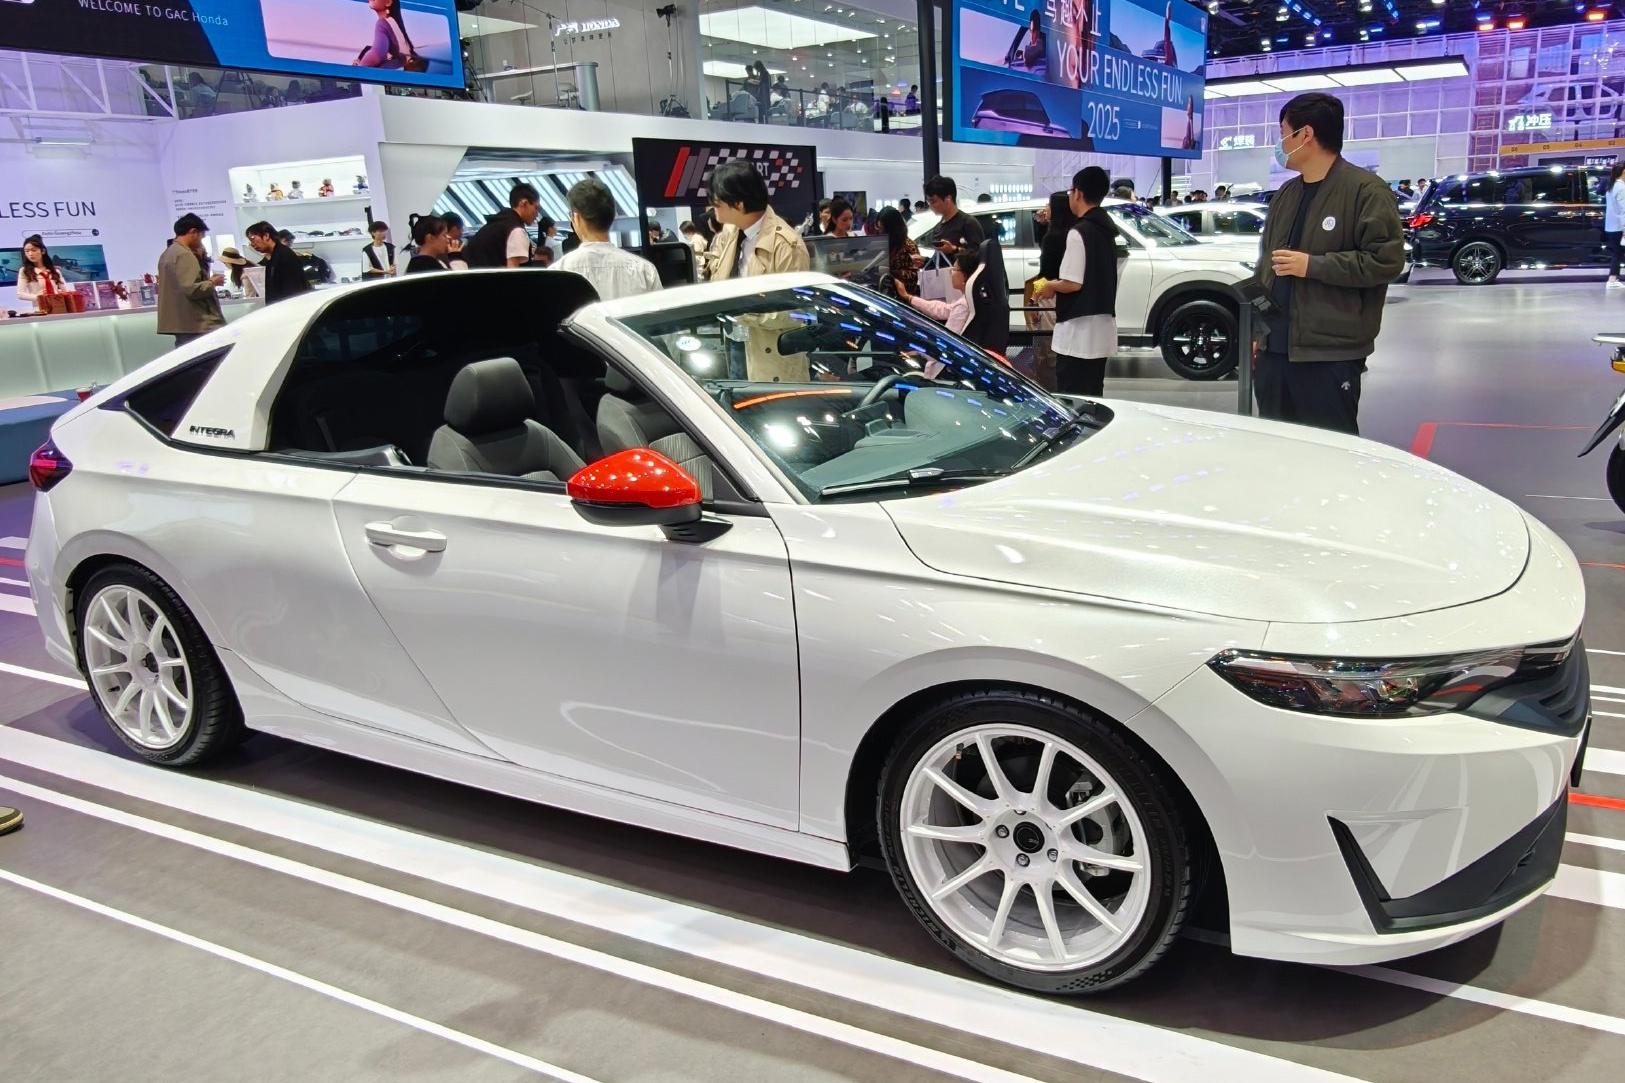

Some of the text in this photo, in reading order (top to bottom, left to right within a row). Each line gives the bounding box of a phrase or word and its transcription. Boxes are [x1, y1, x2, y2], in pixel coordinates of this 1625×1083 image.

[78, 0, 229, 26] WELCOME TO GAC Honda
[1057, 40, 1100, 86] YOUR
[1103, 54, 1159, 99] ENDLESS
[1087, 101, 1120, 140] 2025
[1525, 113, 1552, 126] 冲压
[54, 200, 97, 217] FUN
[190, 425, 235, 437] INTEGRA
